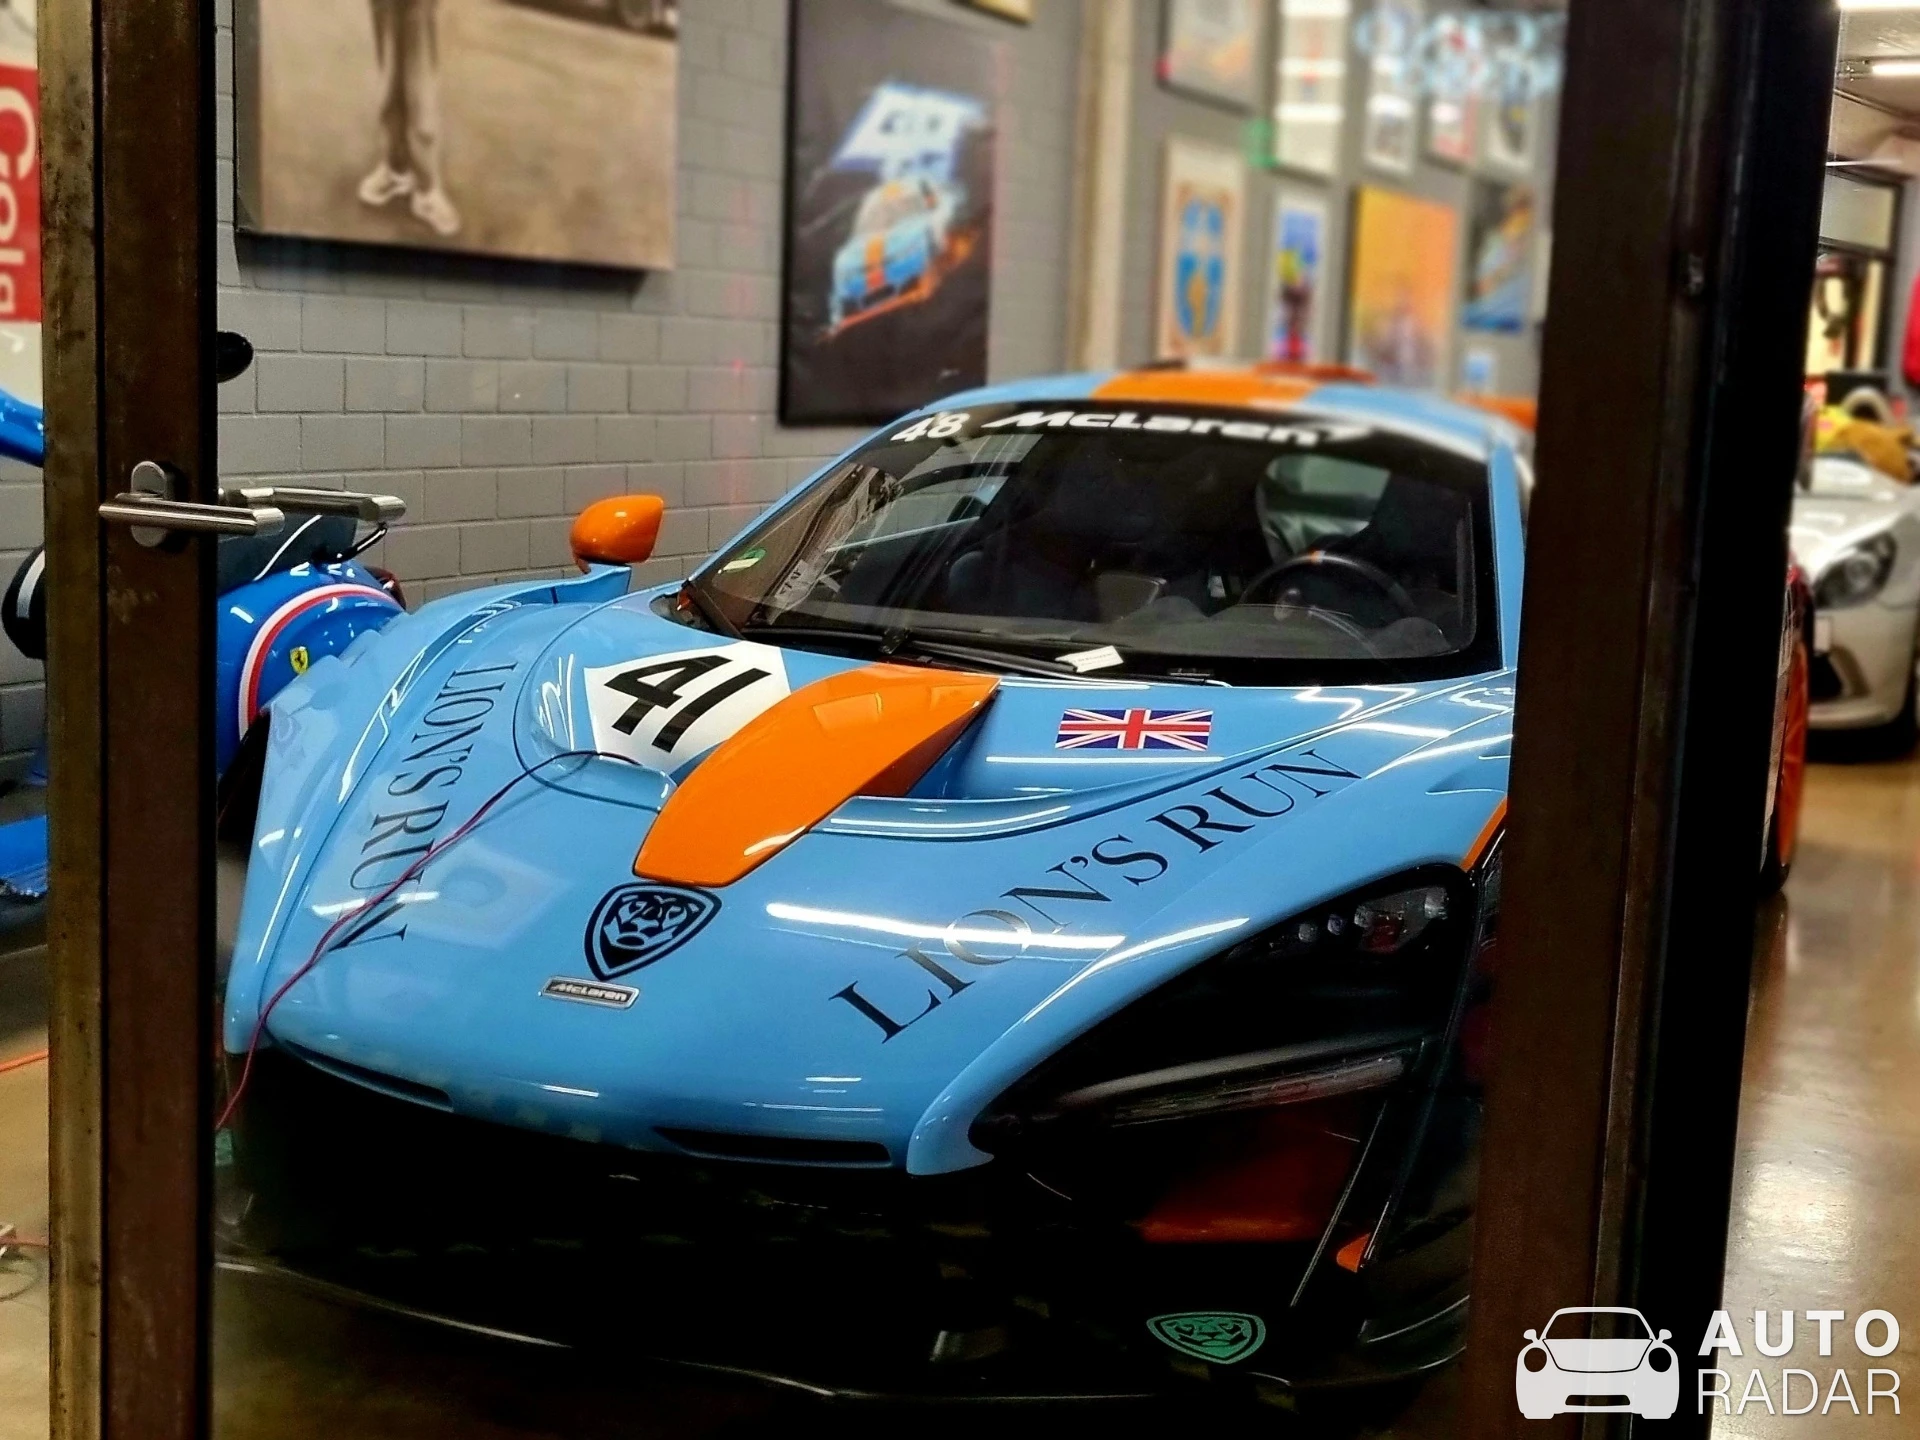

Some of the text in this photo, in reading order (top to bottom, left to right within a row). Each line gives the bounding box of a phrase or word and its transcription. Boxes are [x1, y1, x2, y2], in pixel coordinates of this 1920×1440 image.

[890, 411, 971, 442] 48
[981, 411, 1318, 445] McLaren
[603, 654, 772, 754] 41
[328, 661, 518, 952] LION'S RUN
[828, 749, 1362, 1044] LION'S RUN
[550, 982, 628, 1002] McLaren
